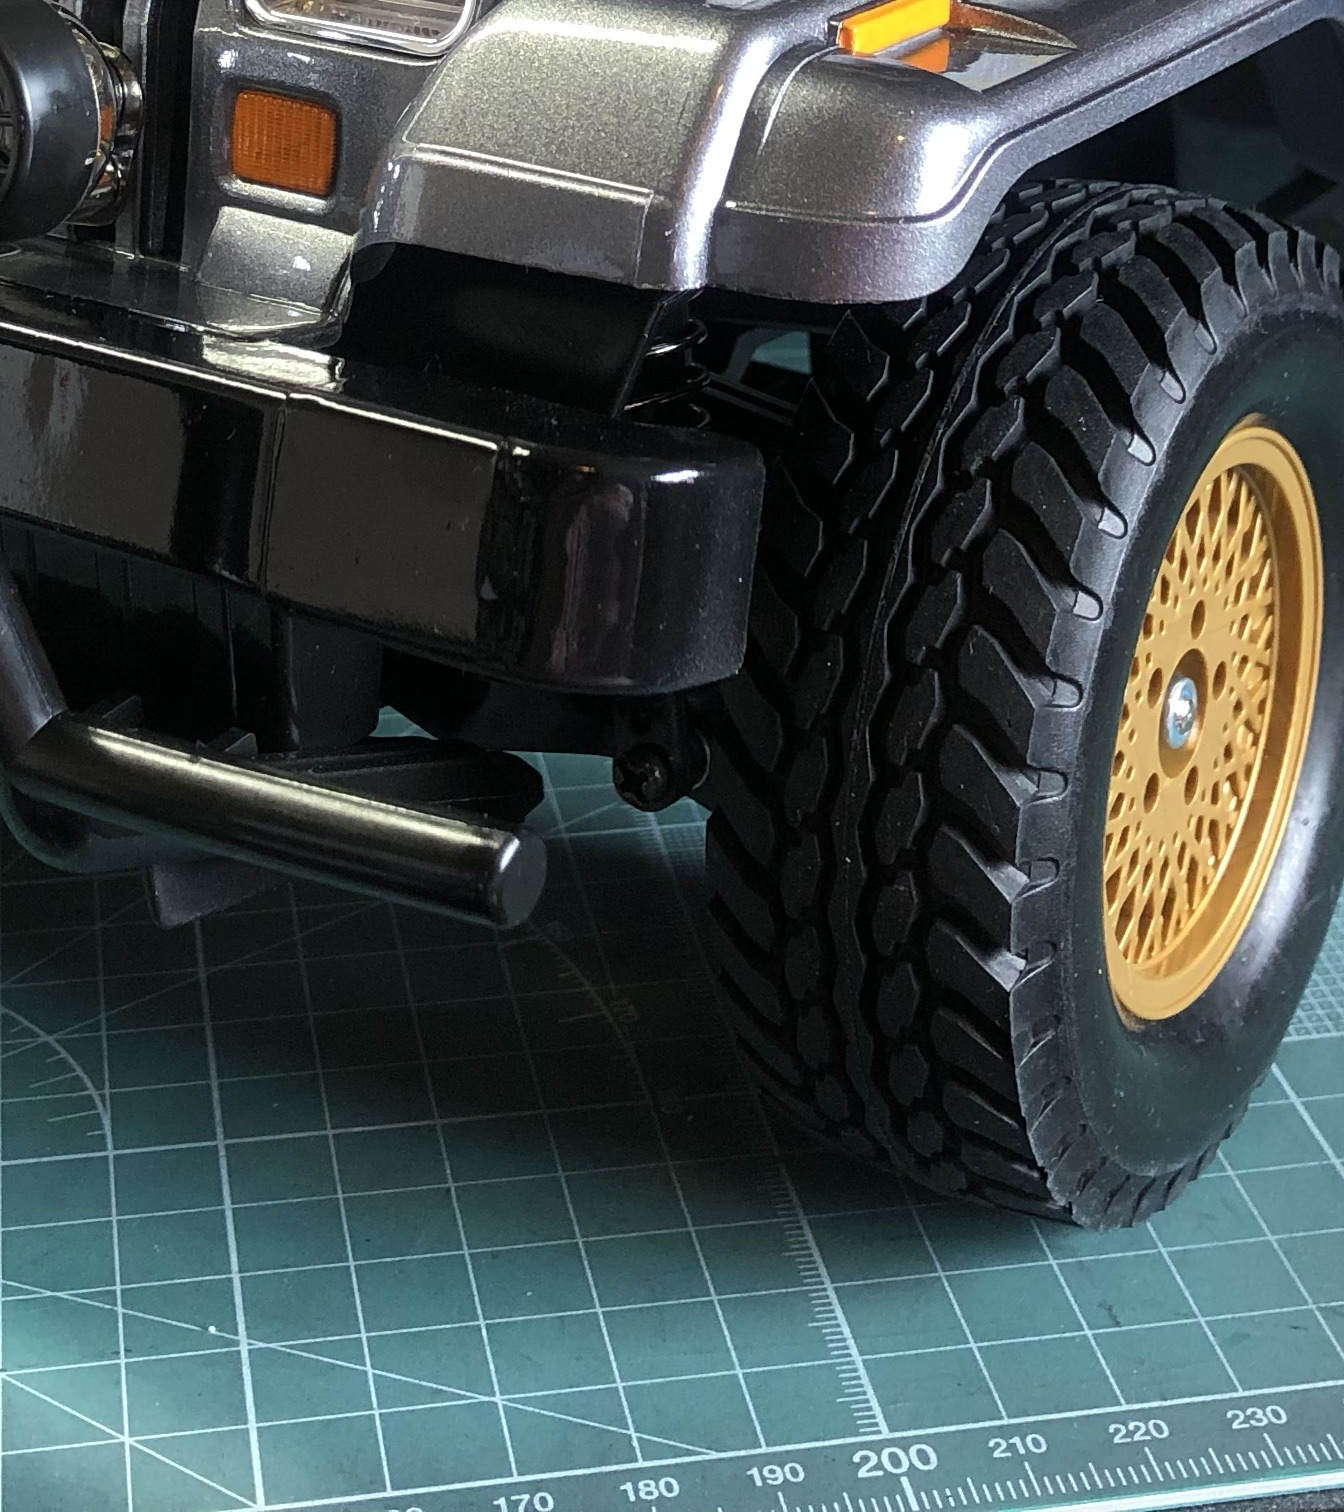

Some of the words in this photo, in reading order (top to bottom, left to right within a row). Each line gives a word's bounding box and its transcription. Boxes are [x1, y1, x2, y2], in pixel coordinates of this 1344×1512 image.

[620, 1477, 680, 1502] 180
[746, 1462, 805, 1487] 190
[852, 1443, 938, 1478] 200
[988, 1433, 1048, 1458] 210
[1108, 1419, 1170, 1444] 220
[1226, 1405, 1287, 1429] 230
